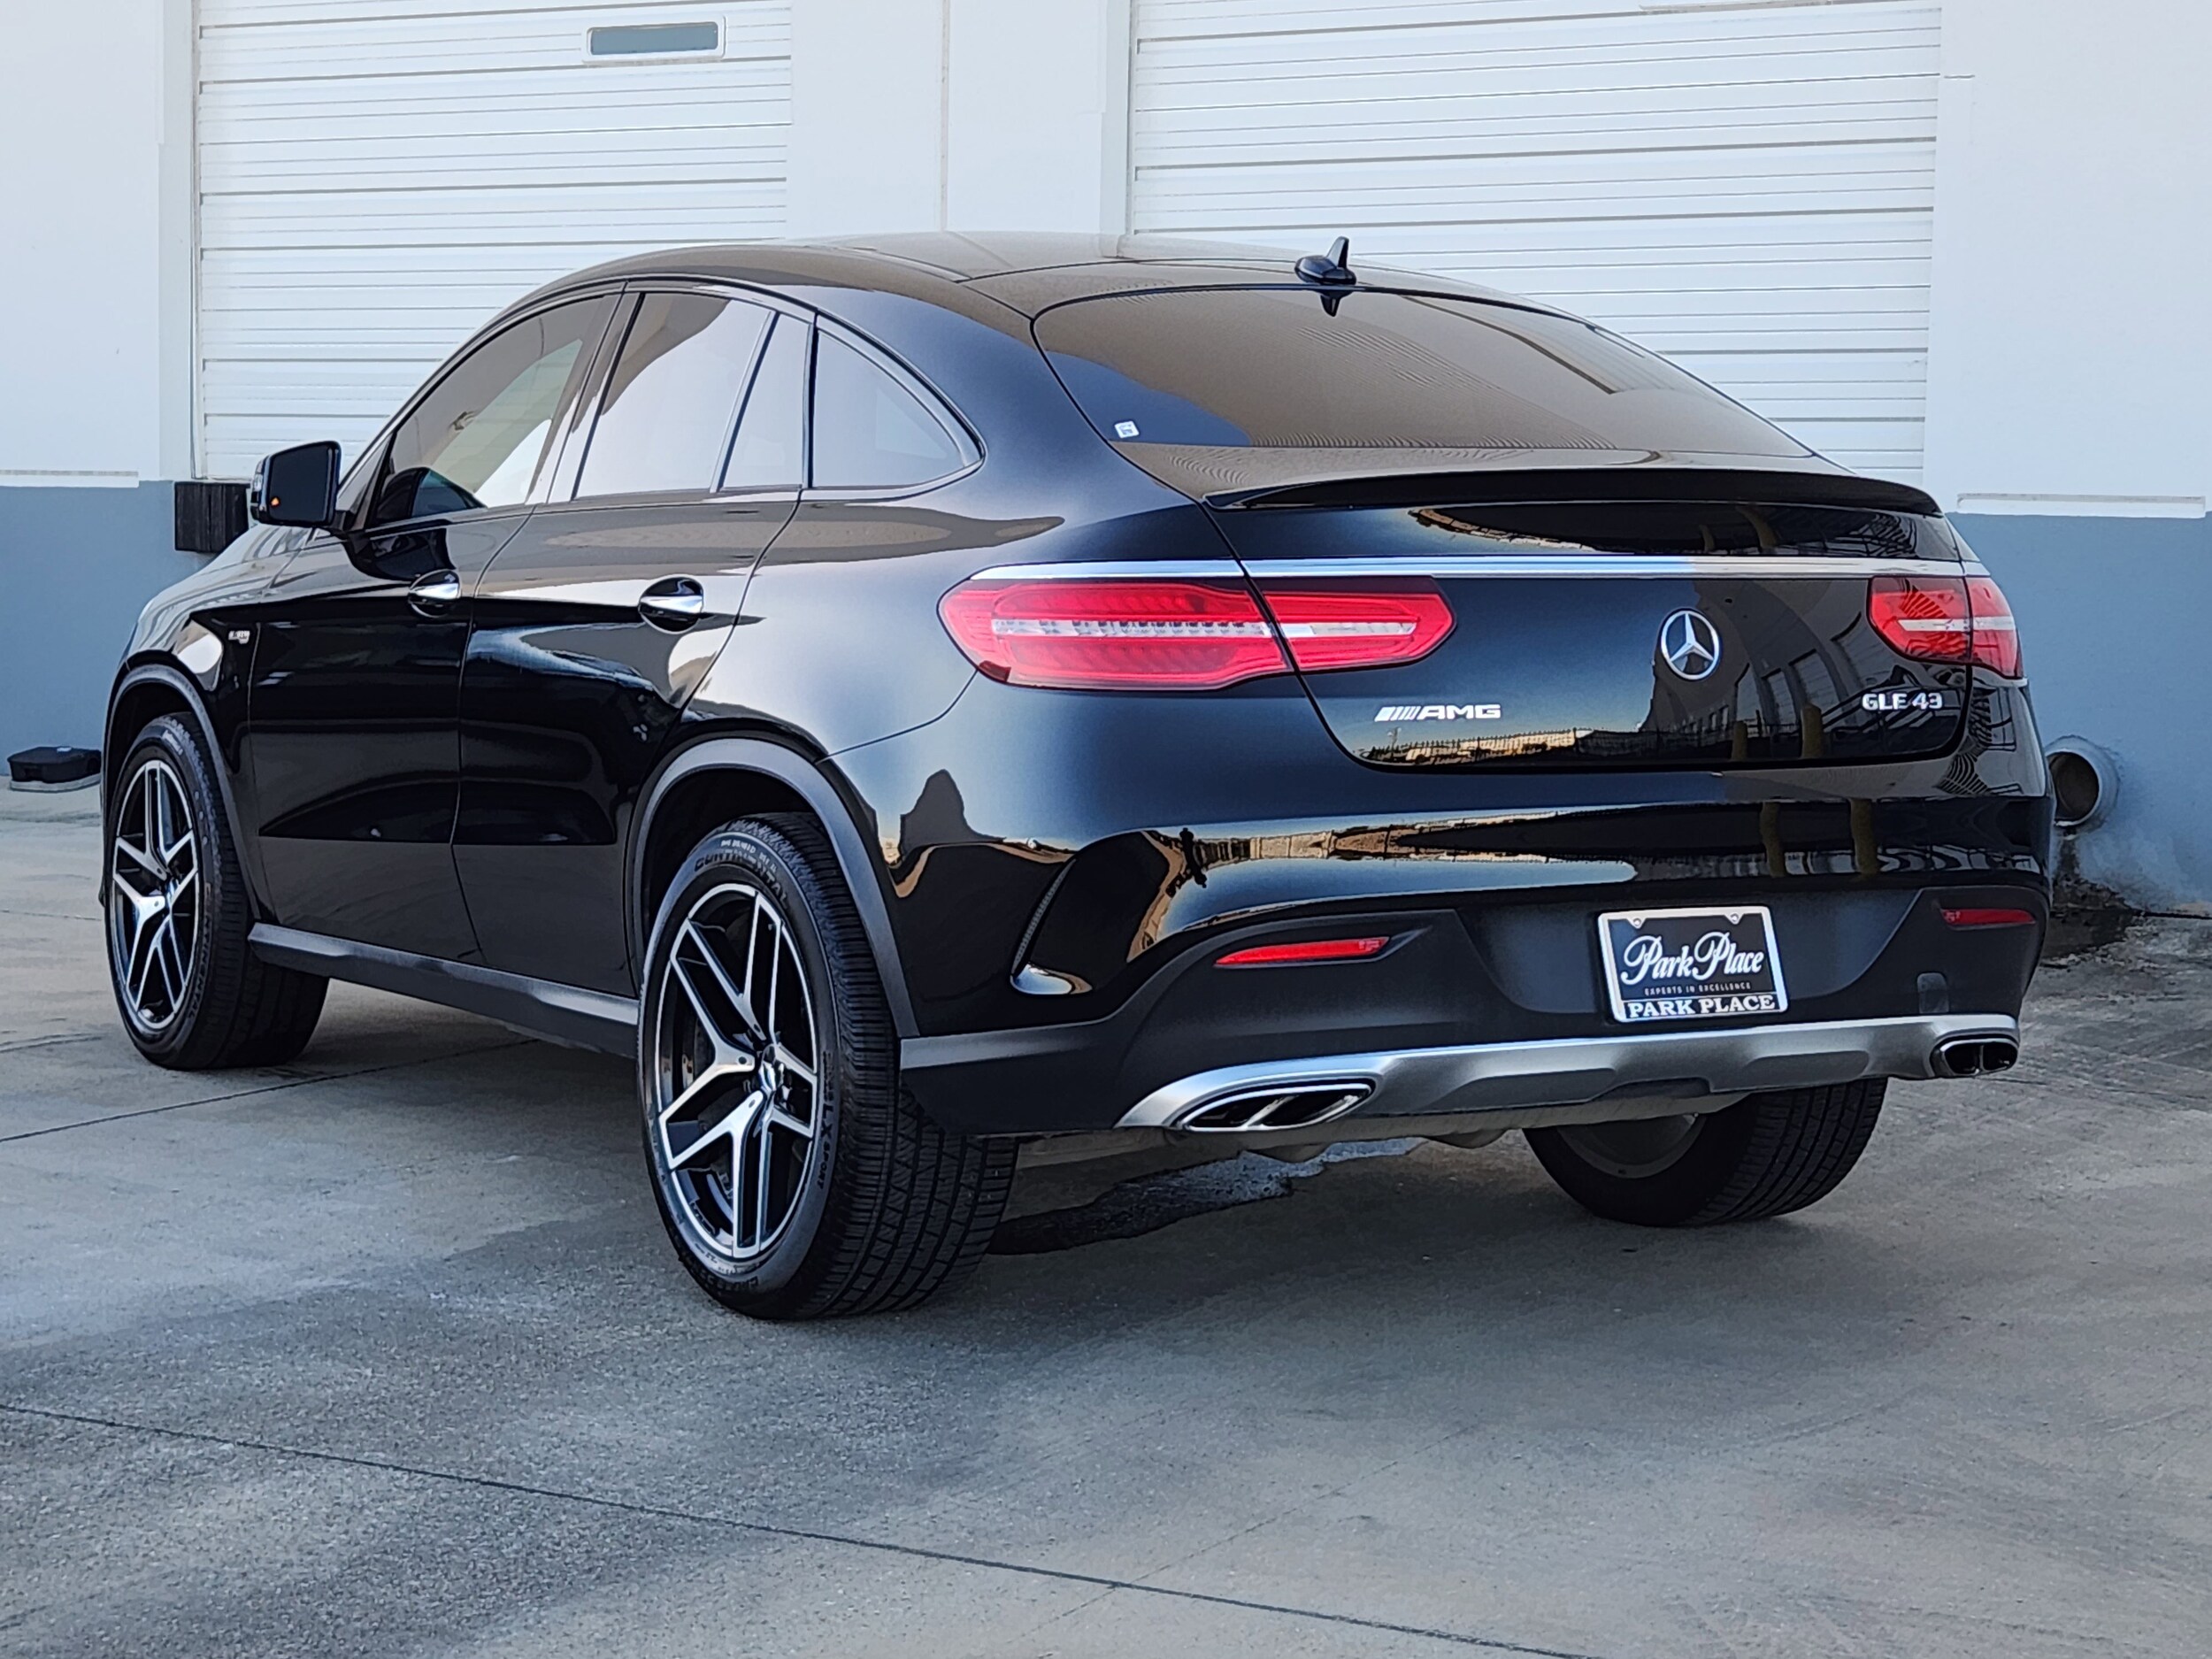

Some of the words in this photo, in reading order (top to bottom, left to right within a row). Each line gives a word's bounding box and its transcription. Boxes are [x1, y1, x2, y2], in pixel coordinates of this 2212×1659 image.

[1862, 693, 1908, 710] GLE
[1912, 692, 1943, 710] 43
[1417, 704, 1502, 720] AMG
[1620, 935, 1694, 985] Park
[1692, 932, 1764, 980] Place
[1644, 986, 1682, 995] EXPERTS
[1686, 985, 1695, 994] IN
[1698, 982, 1752, 993] EXCELLENCE
[1629, 1000, 1696, 1018] PARK
[1698, 995, 1776, 1014] PLACE
